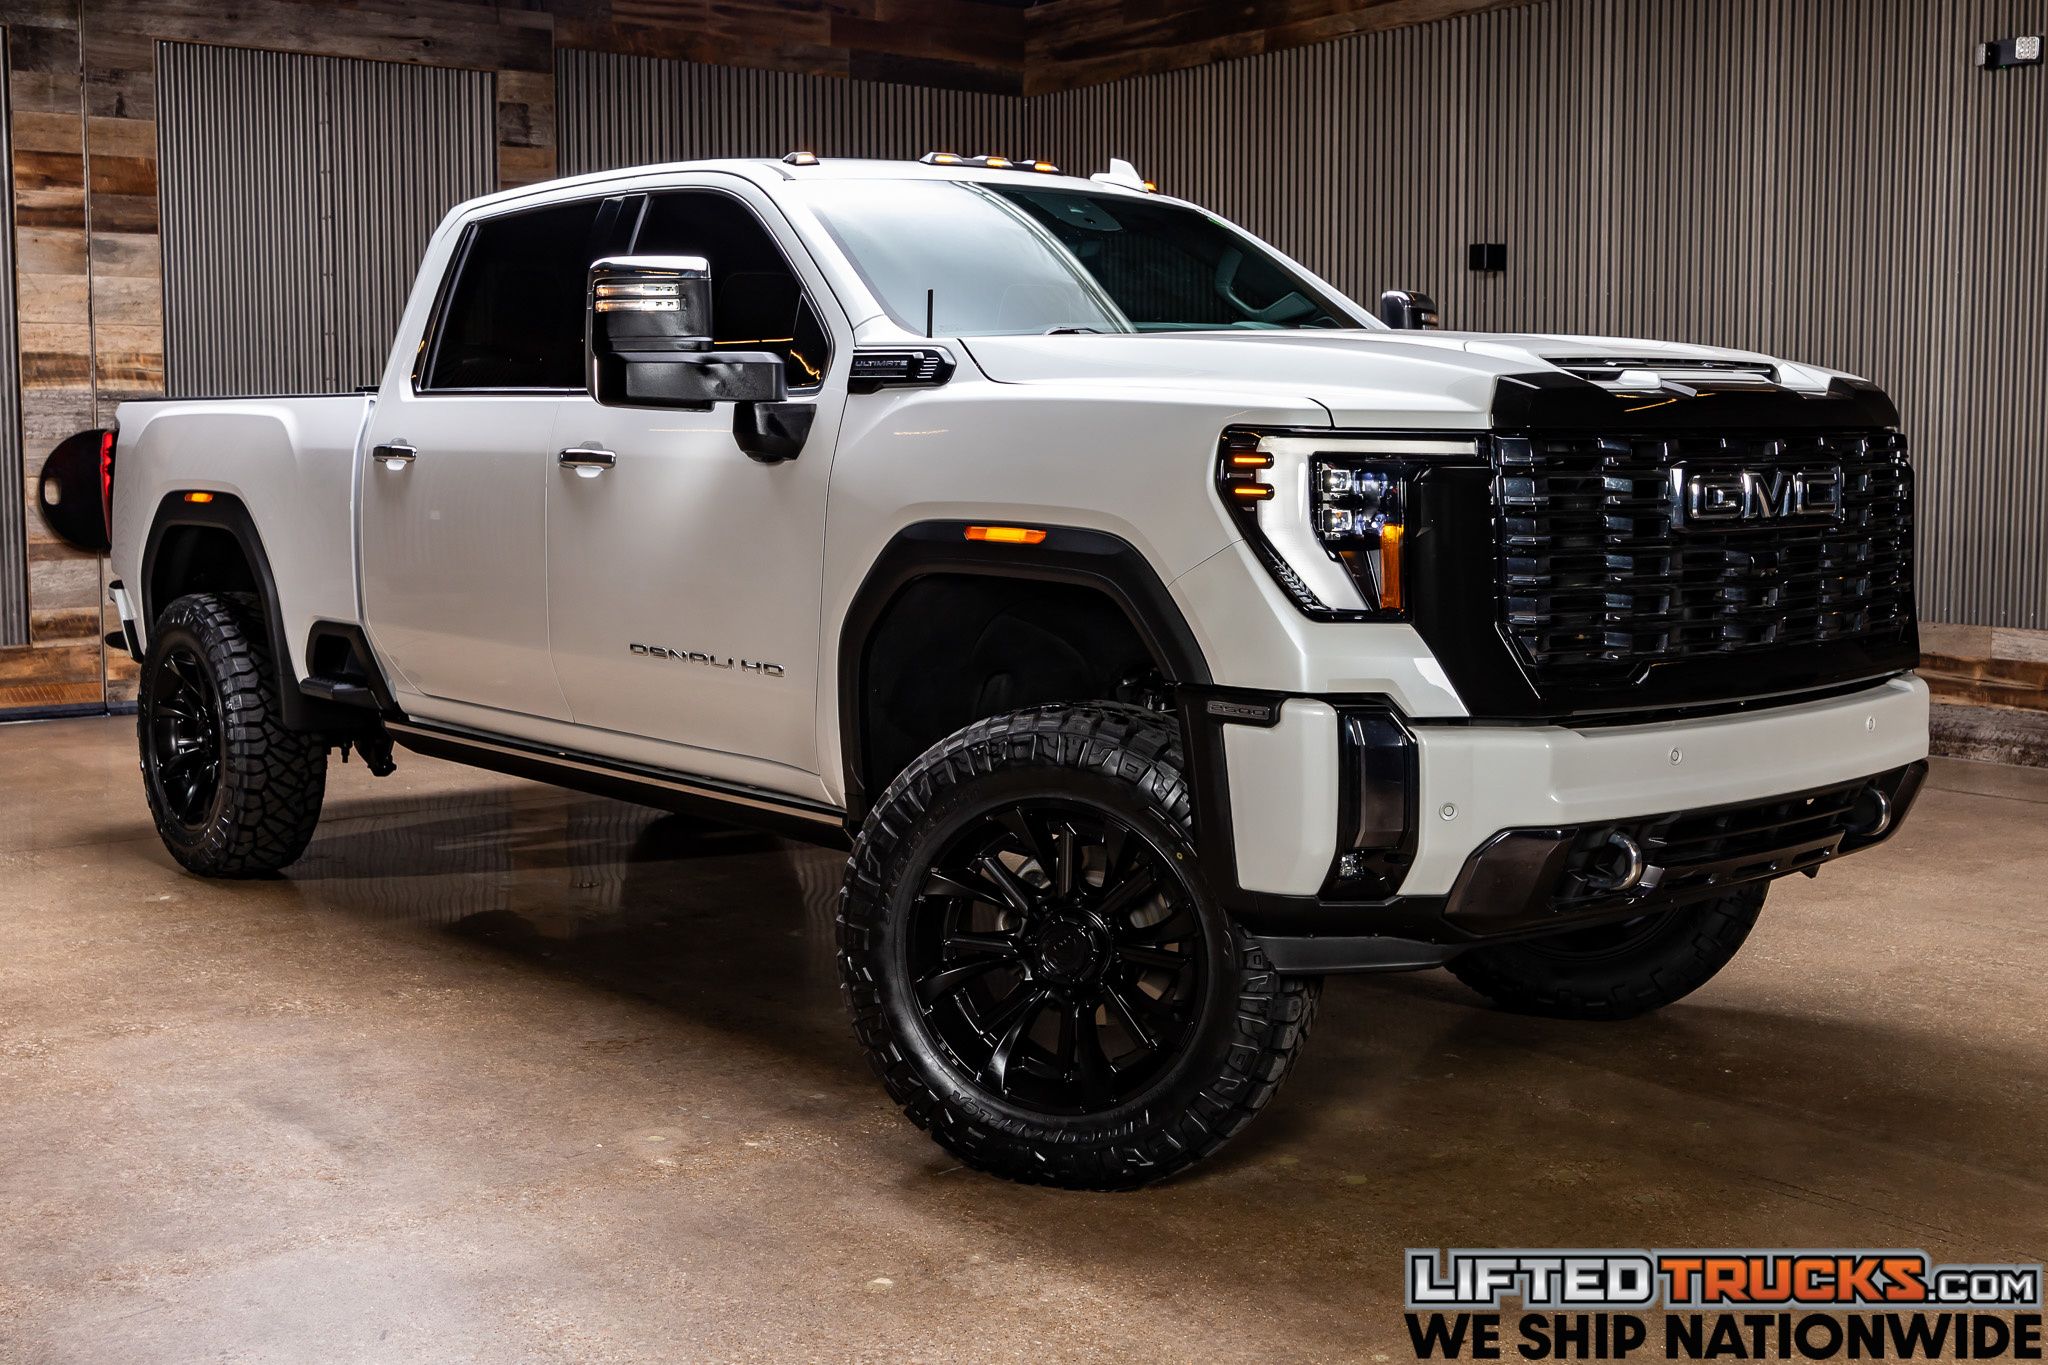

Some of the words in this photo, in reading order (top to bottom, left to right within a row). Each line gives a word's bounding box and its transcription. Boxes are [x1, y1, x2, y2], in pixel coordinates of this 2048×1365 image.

[854, 359, 908, 367] ULTIMATE
[1687, 470, 1838, 519] GMC
[630, 643, 735, 670] DENALI
[741, 659, 786, 678] HD
